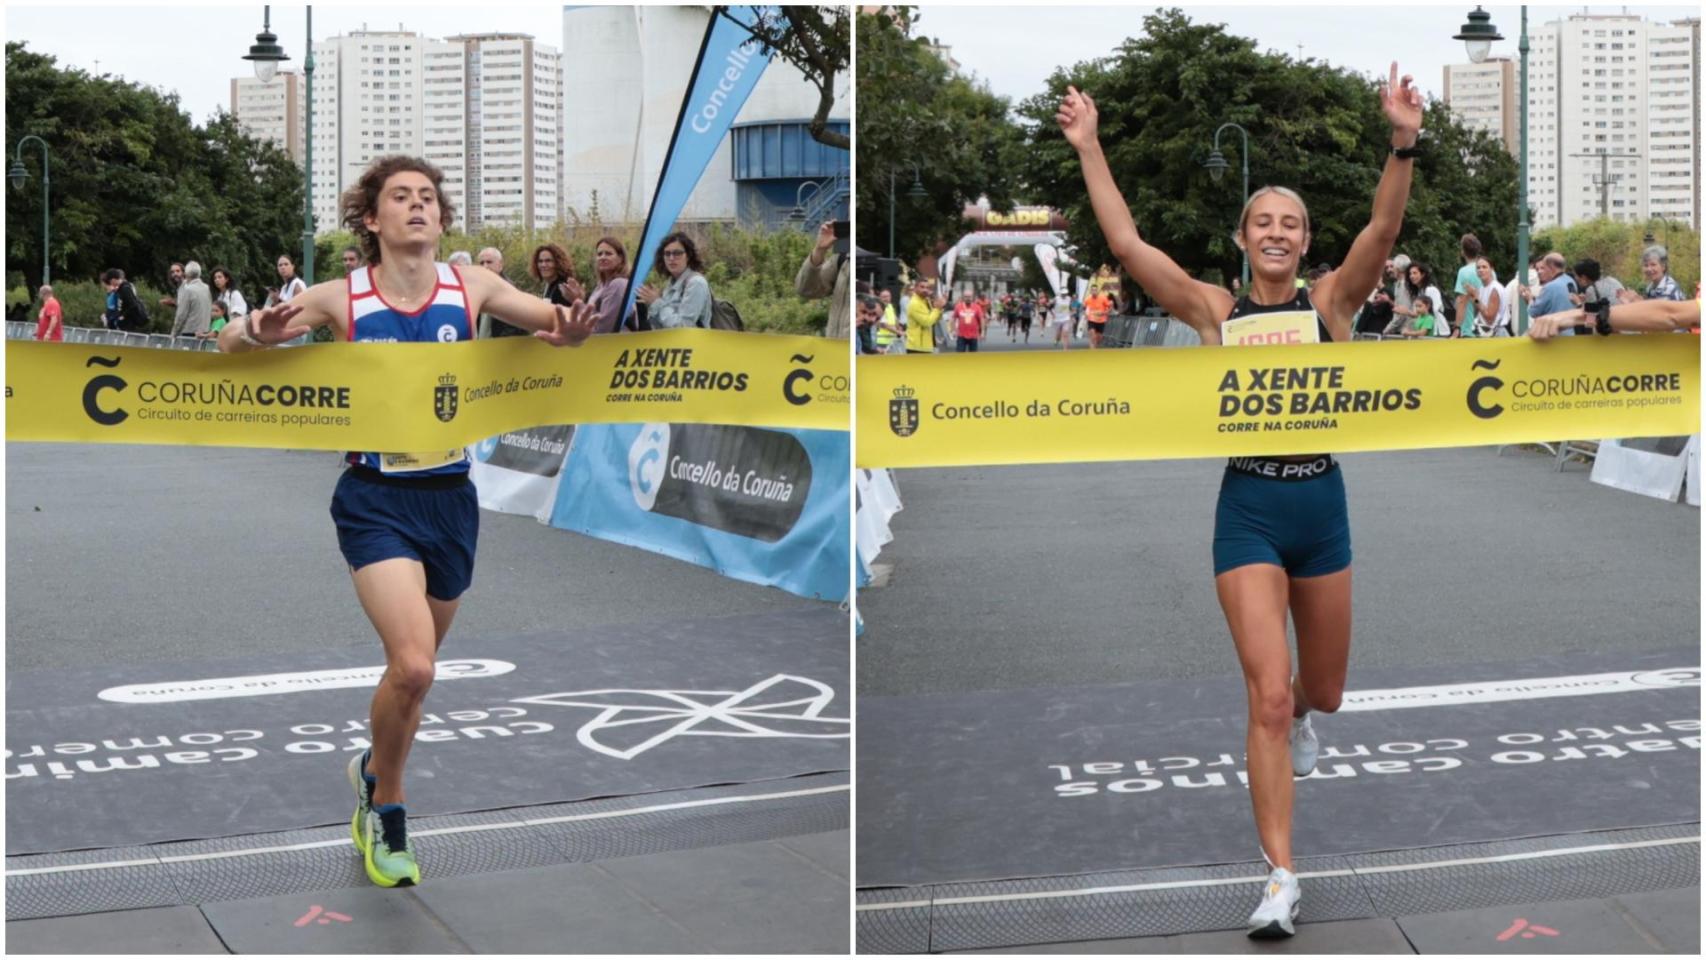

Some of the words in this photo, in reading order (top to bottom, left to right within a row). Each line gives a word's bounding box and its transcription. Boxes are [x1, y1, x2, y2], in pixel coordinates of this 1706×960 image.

[986, 209, 1050, 226] GADIS
[614, 349, 628, 368] A
[629, 348, 693, 368] XENTE
[464, 381, 503, 403] Concello
[505, 377, 519, 395] da
[522, 373, 563, 392] Coruña
[609, 370, 649, 390] DOS
[652, 371, 749, 392] BARRIOS
[819, 375, 850, 392] CO
[1217, 369, 1240, 392] A
[1247, 366, 1345, 391] XENTE
[1511, 372, 1681, 399] CORUÑACORRE
[137, 380, 351, 409] CORUÑACORRE
[606, 394, 632, 403] CORRE
[634, 394, 645, 402] NA
[647, 393, 683, 402] CORUÑA
[1219, 393, 1283, 417] DOS
[1288, 388, 1422, 415] BARRIOS
[1511, 400, 1555, 412] Circuito
[1558, 398, 1572, 410] de
[1575, 397, 1624, 409] carreiras
[1627, 394, 1682, 409] populares
[137, 408, 191, 422] Circuito
[194, 410, 213, 423] de
[215, 411, 278, 424] carreiras
[281, 413, 351, 428] populares
[932, 400, 1019, 420] Concello
[1026, 399, 1051, 418] da
[1057, 397, 1131, 416] Coruña
[1218, 421, 1260, 433] CORRE
[1264, 421, 1282, 431] NA
[1284, 418, 1338, 431] CORUÑA
[500, 432, 530, 449] Concello
[530, 435, 540, 451] da
[1230, 456, 1280, 476] NIKE
[1282, 457, 1327, 475] PRO
[723, 465, 740, 491] da
[743, 470, 793, 502] Coruña
[287, 672, 385, 685] oncello
[290, 706, 527, 735] cenro
[5, 729, 264, 758] comer
[284, 721, 555, 754] cuaro
[1047, 738, 1469, 780] comrcial
